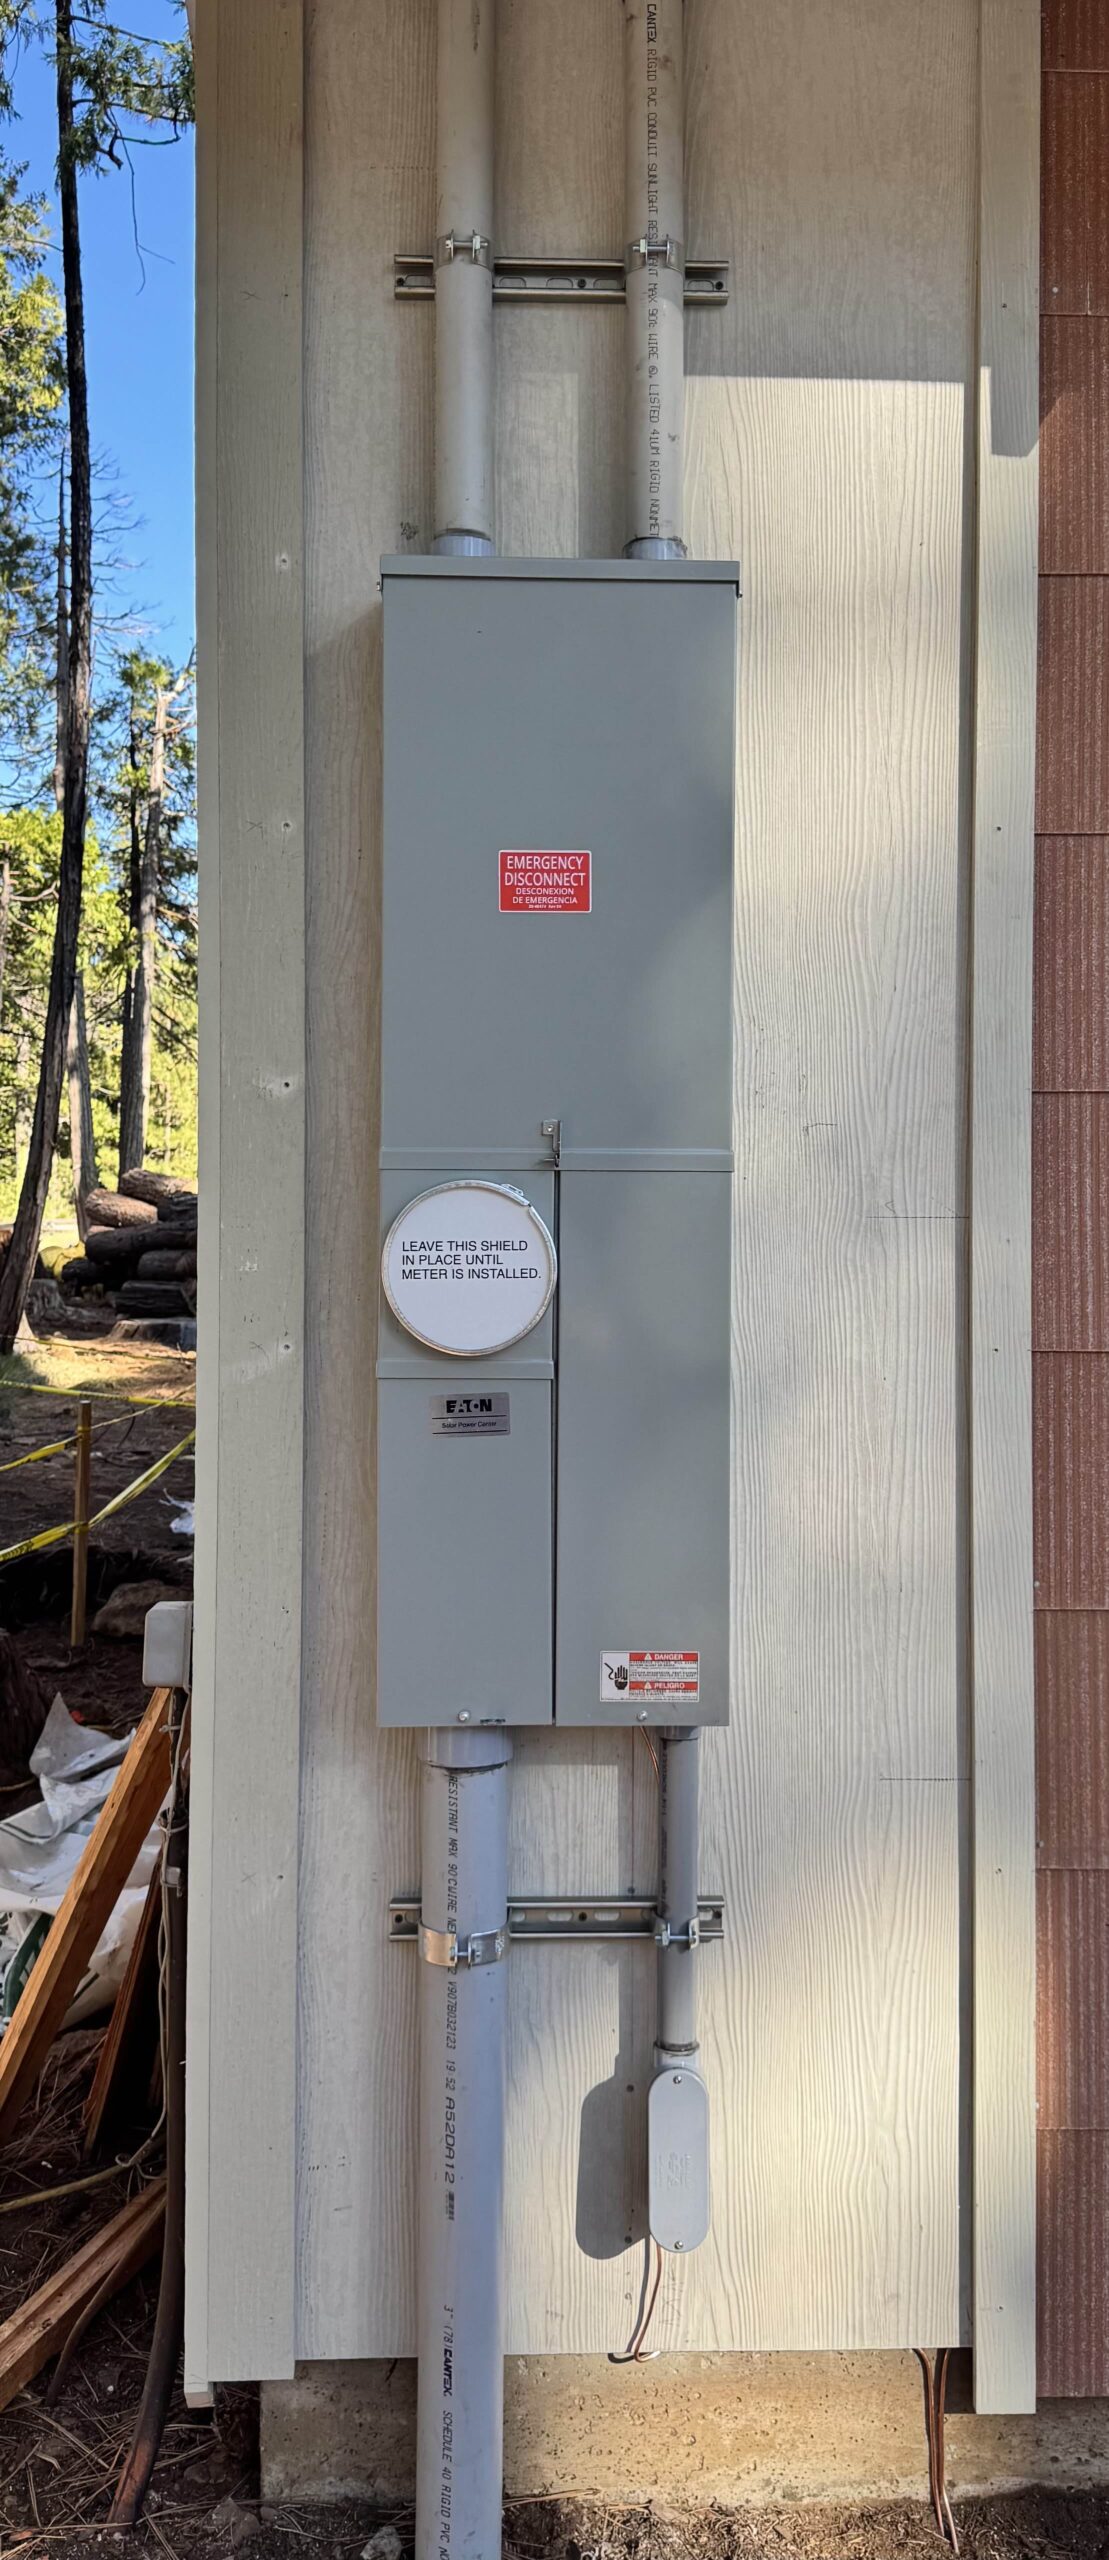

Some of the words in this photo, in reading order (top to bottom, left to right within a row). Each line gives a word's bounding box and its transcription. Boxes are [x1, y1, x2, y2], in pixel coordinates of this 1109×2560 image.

[646, 4, 657, 43] CANTEX
[646, 49, 657, 82] RIGID
[647, 87, 658, 107] PVC
[647, 112, 658, 157] CONDUIT
[648, 163, 658, 214] SUNLIGHT
[648, 220, 658, 277] RESITANT
[648, 283, 658, 303] MAX
[648, 333, 658, 360] WIRE
[649, 384, 660, 423] LISTED
[649, 460, 660, 493] RIGID
[506, 855, 584, 870] EMERGENCY
[504, 872, 586, 886] DISCONNECT
[512, 896, 523, 904] DE
[525, 896, 577, 904] EMERGENCIA
[515, 887, 575, 895] DESCONEXION
[402, 1240, 443, 1252] LEAVE
[447, 1240, 477, 1251] THIS
[481, 1240, 528, 1251] SHIELD
[402, 1255, 415, 1265] IN
[419, 1255, 462, 1265] PLACE
[465, 1254, 504, 1265] UNTIL
[402, 1269, 448, 1280] METER
[452, 1269, 464, 1279] IS
[468, 1268, 542, 1279] INSTALLED.
[446, 1398, 492, 1413] EATON
[447, 1775, 458, 1833] RESISTANT
[447, 1837, 458, 1858] MAX
[444, 2096, 456, 2184] A52DA12
[442, 2410, 453, 2462] SCHEDULE
[441, 2466, 452, 2481] 40
[440, 2484, 452, 2518] RIGID
[440, 2522, 451, 2543] PVC
